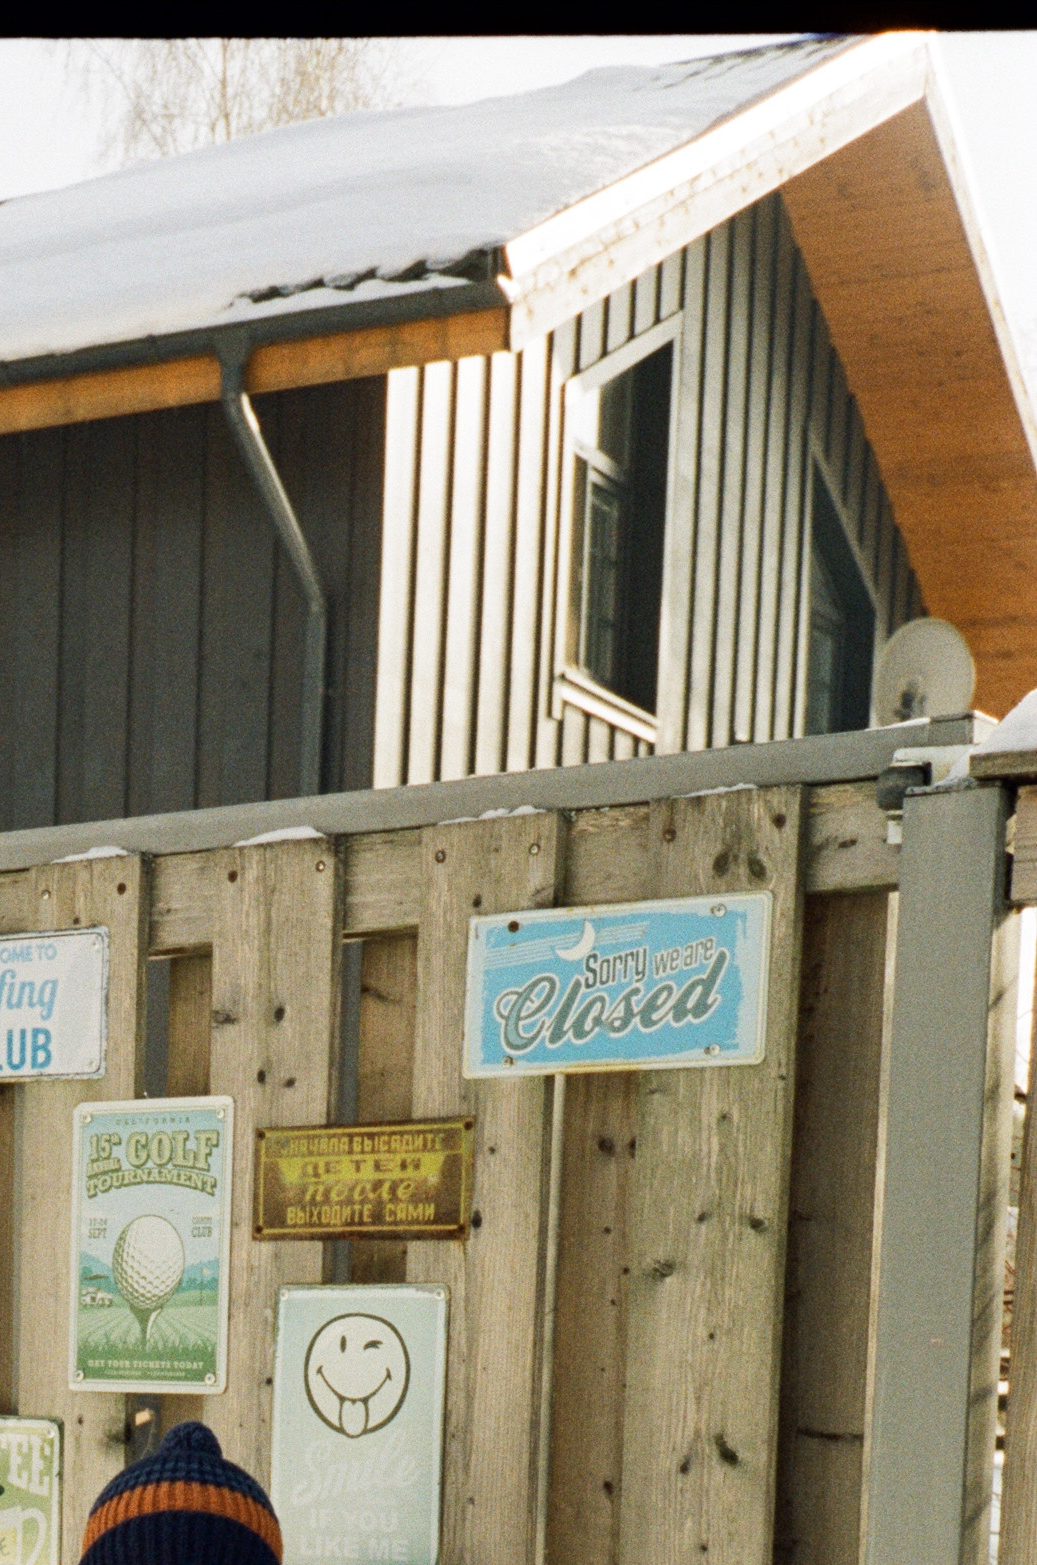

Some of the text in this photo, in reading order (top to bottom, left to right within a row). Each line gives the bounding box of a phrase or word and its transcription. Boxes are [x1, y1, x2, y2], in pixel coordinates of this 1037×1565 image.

[37, 942, 58, 962] TO
[584, 937, 716, 990] Sorry we are
[494, 949, 729, 1052] Closed
[126, 1130, 220, 1173] GOLF
[85, 1168, 218, 1199] TOURNAMENT
[287, 1202, 435, 1226] ВЫХОДИТЕ САМИ
[309, 1508, 399, 1533] IF YOU
[299, 1534, 409, 1562] LIKE ME
